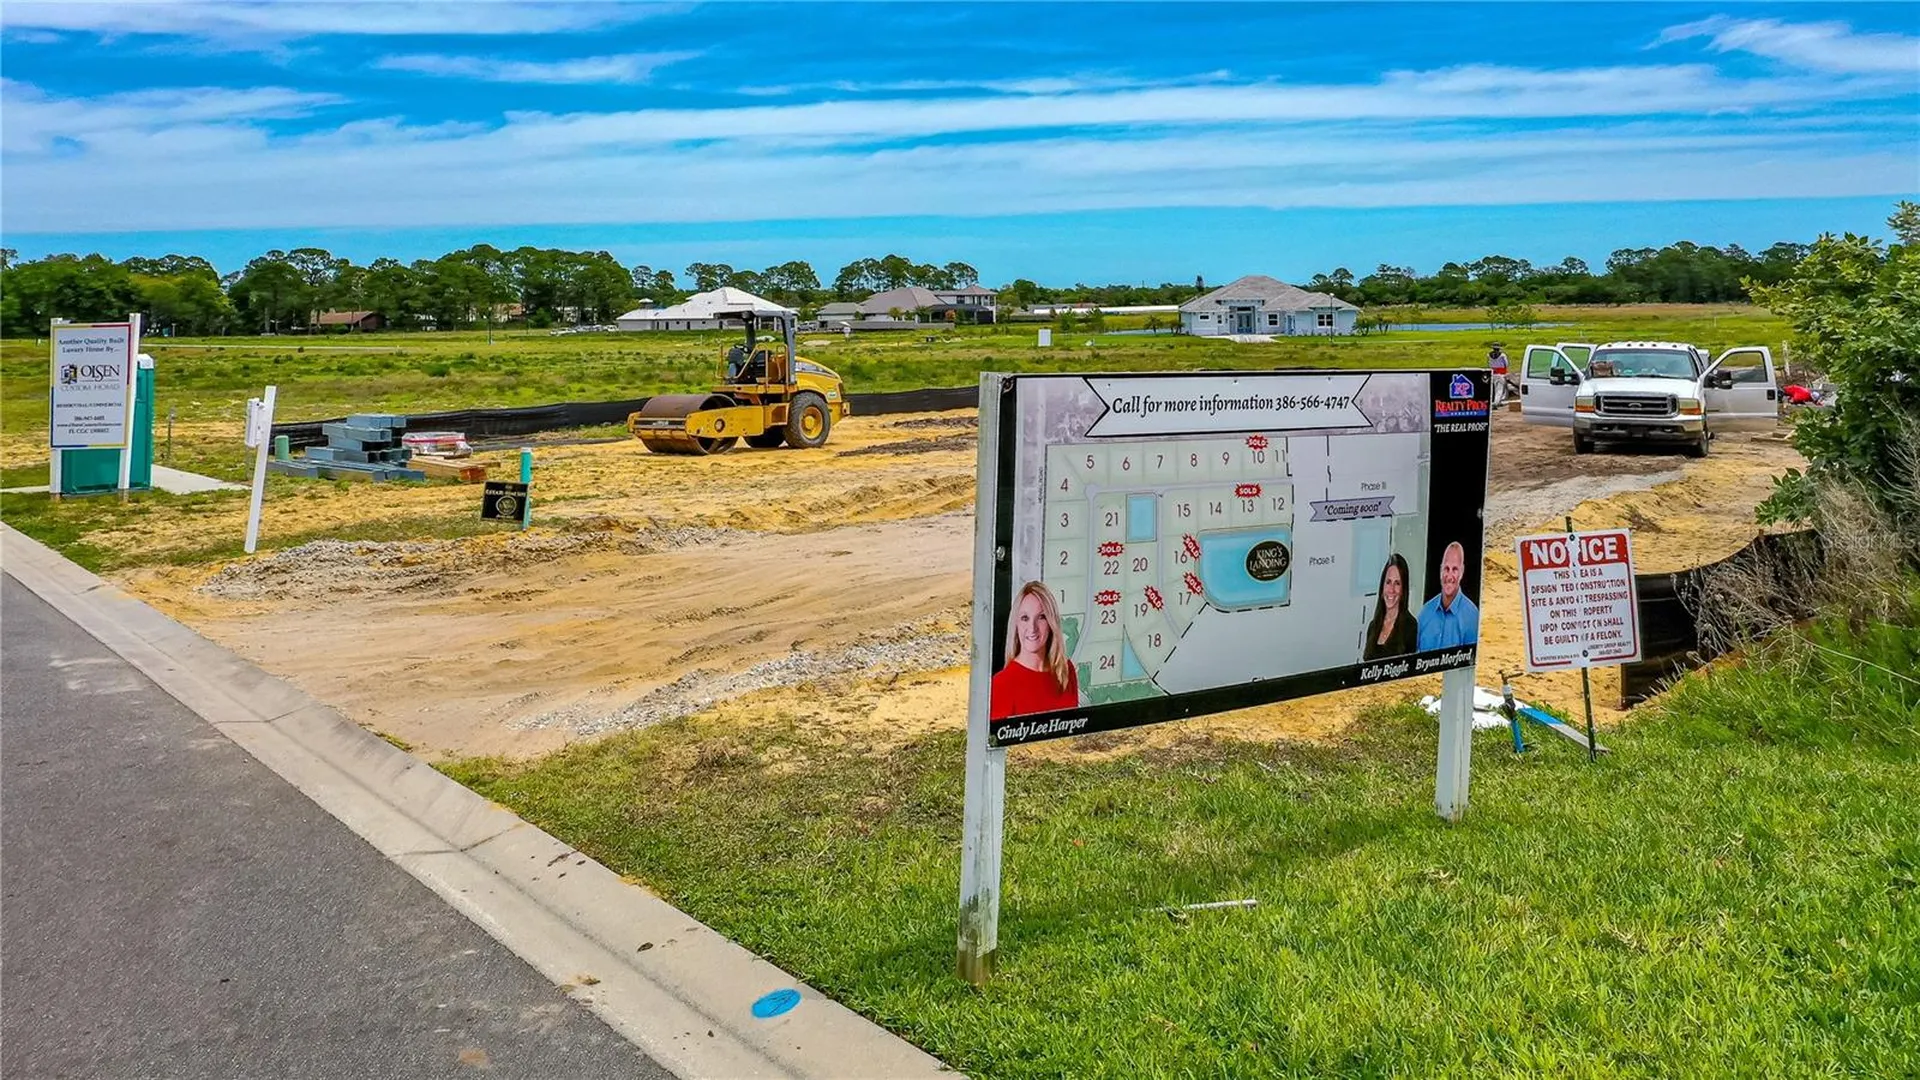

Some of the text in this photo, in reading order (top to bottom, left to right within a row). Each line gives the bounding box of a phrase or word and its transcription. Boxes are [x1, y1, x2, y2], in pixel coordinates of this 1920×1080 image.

[1112, 393, 1350, 418] Call for more information 386-566-4747
[1450, 422, 1467, 432] REAL
[1248, 439, 1267, 447] SOLD
[1086, 455, 1095, 469] 5
[1156, 454, 1164, 468] 7
[1190, 452, 1198, 467] 8
[1222, 452, 1230, 465] 9
[1252, 450, 1266, 464] 10
[1275, 449, 1286, 463] 11
[1122, 457, 1131, 471] 6
[1060, 478, 1068, 491] 4
[1238, 487, 1257, 496] SOLD
[1361, 482, 1381, 491] Phase
[1177, 504, 1191, 517] 15
[1209, 502, 1222, 515] 14
[1242, 500, 1255, 513] 13
[1273, 498, 1285, 511] 12
[1060, 513, 1069, 528] 3
[1105, 512, 1120, 527] 21
[1101, 545, 1121, 554] SOLD
[1256, 546, 1283, 559] KING'S
[1530, 537, 1619, 566] NOICE
[1060, 551, 1069, 566] 2
[1132, 557, 1149, 572] 20
[1174, 551, 1188, 564] 16
[1250, 556, 1287, 571] LANDING
[1309, 557, 1330, 566] Phase
[1104, 561, 1120, 575] 22
[1553, 567, 1603, 580] THIS EA IS A
[1531, 583, 1574, 594] DESIGNTED
[1060, 589, 1066, 603] 1
[1097, 593, 1118, 602] SOLD
[1178, 592, 1192, 605] 17
[1531, 598, 1546, 607] SITE
[1549, 598, 1554, 606] &
[1585, 591, 1628, 603] TRESPASSING
[1101, 610, 1117, 624] 23
[1134, 603, 1148, 617] 19
[1550, 605, 1613, 619] ON THIS ROPERTY
[1603, 617, 1624, 627] SHALL
[1148, 633, 1162, 647] 18
[1544, 636, 1553, 645] BE
[1554, 634, 1579, 644] GUILTY
[1590, 632, 1595, 641] A
[1099, 655, 1115, 669] 24
[1360, 665, 1382, 680] Kelly
[1382, 660, 1410, 677] Riggle
[1415, 657, 1440, 671] Bryan
[997, 718, 1089, 741] Cindy Lee Harper
